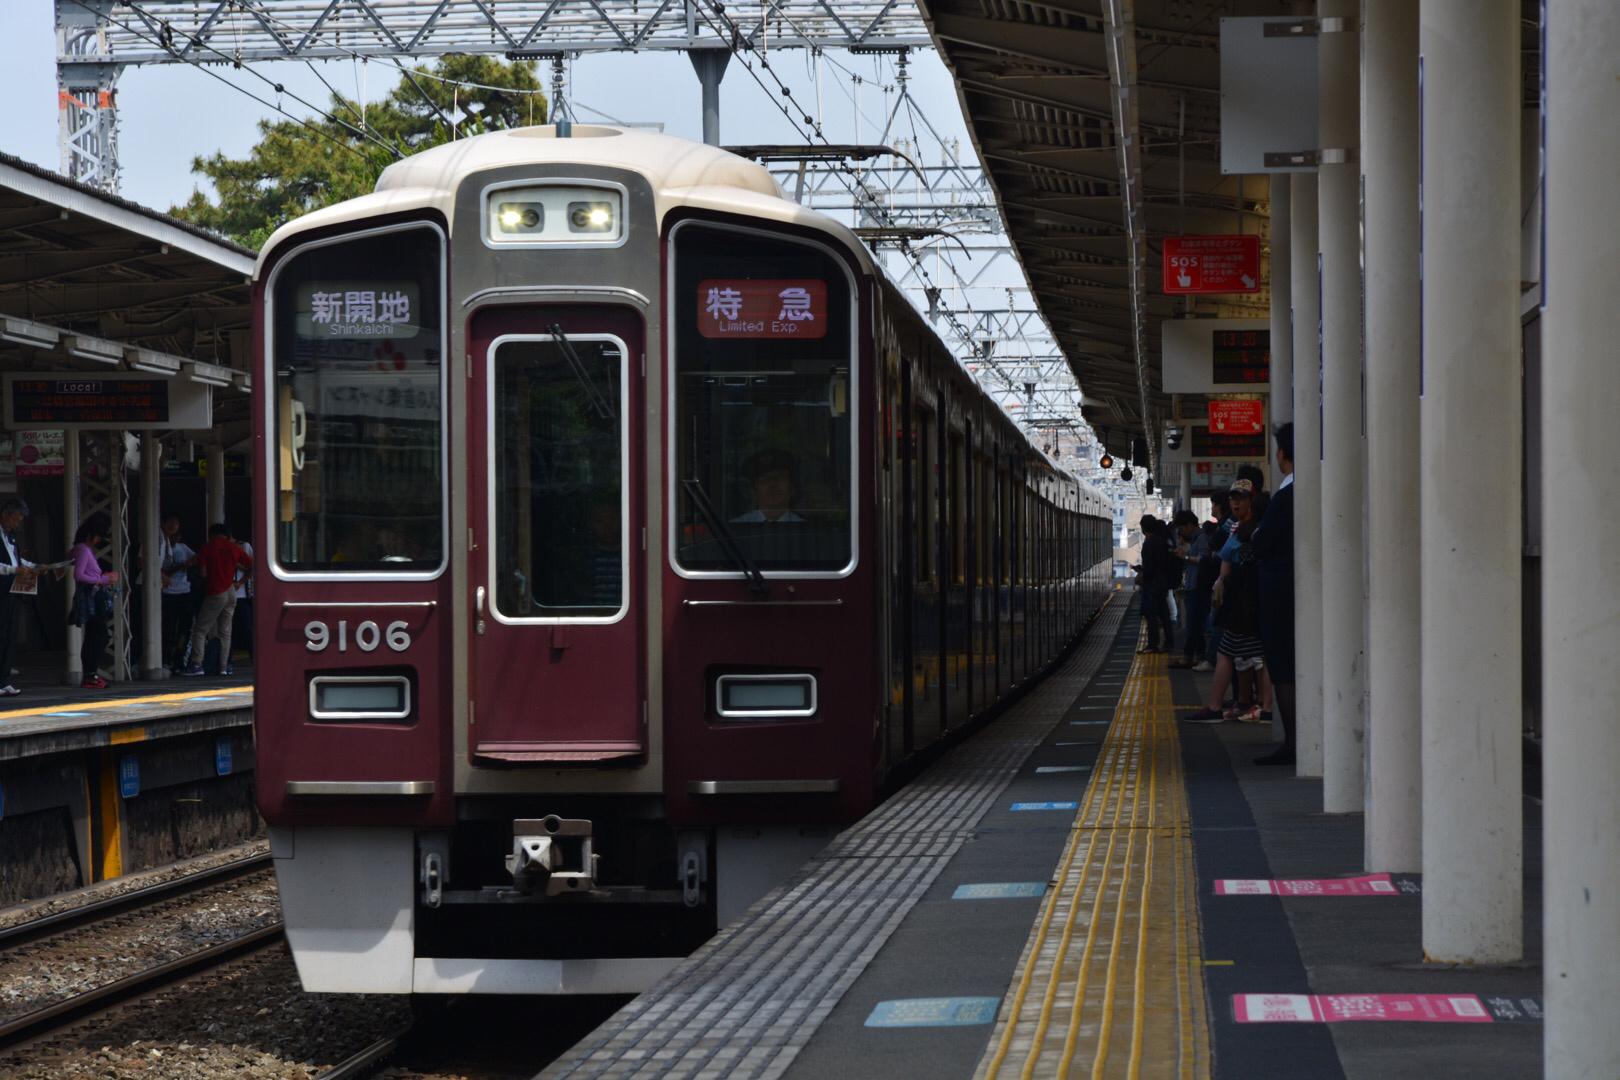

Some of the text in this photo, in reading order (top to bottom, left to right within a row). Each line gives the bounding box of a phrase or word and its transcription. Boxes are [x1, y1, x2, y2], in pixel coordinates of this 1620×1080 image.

[1171, 256, 1198, 267] SOS
[311, 291, 410, 323] 新開地
[706, 287, 814, 321] 特急
[330, 323, 394, 335] Shinkaichi
[719, 321, 799, 334] Limited Exp.
[63, 383, 96, 392] Local
[1213, 411, 1228, 419] SOS
[304, 620, 411, 651] 9106
